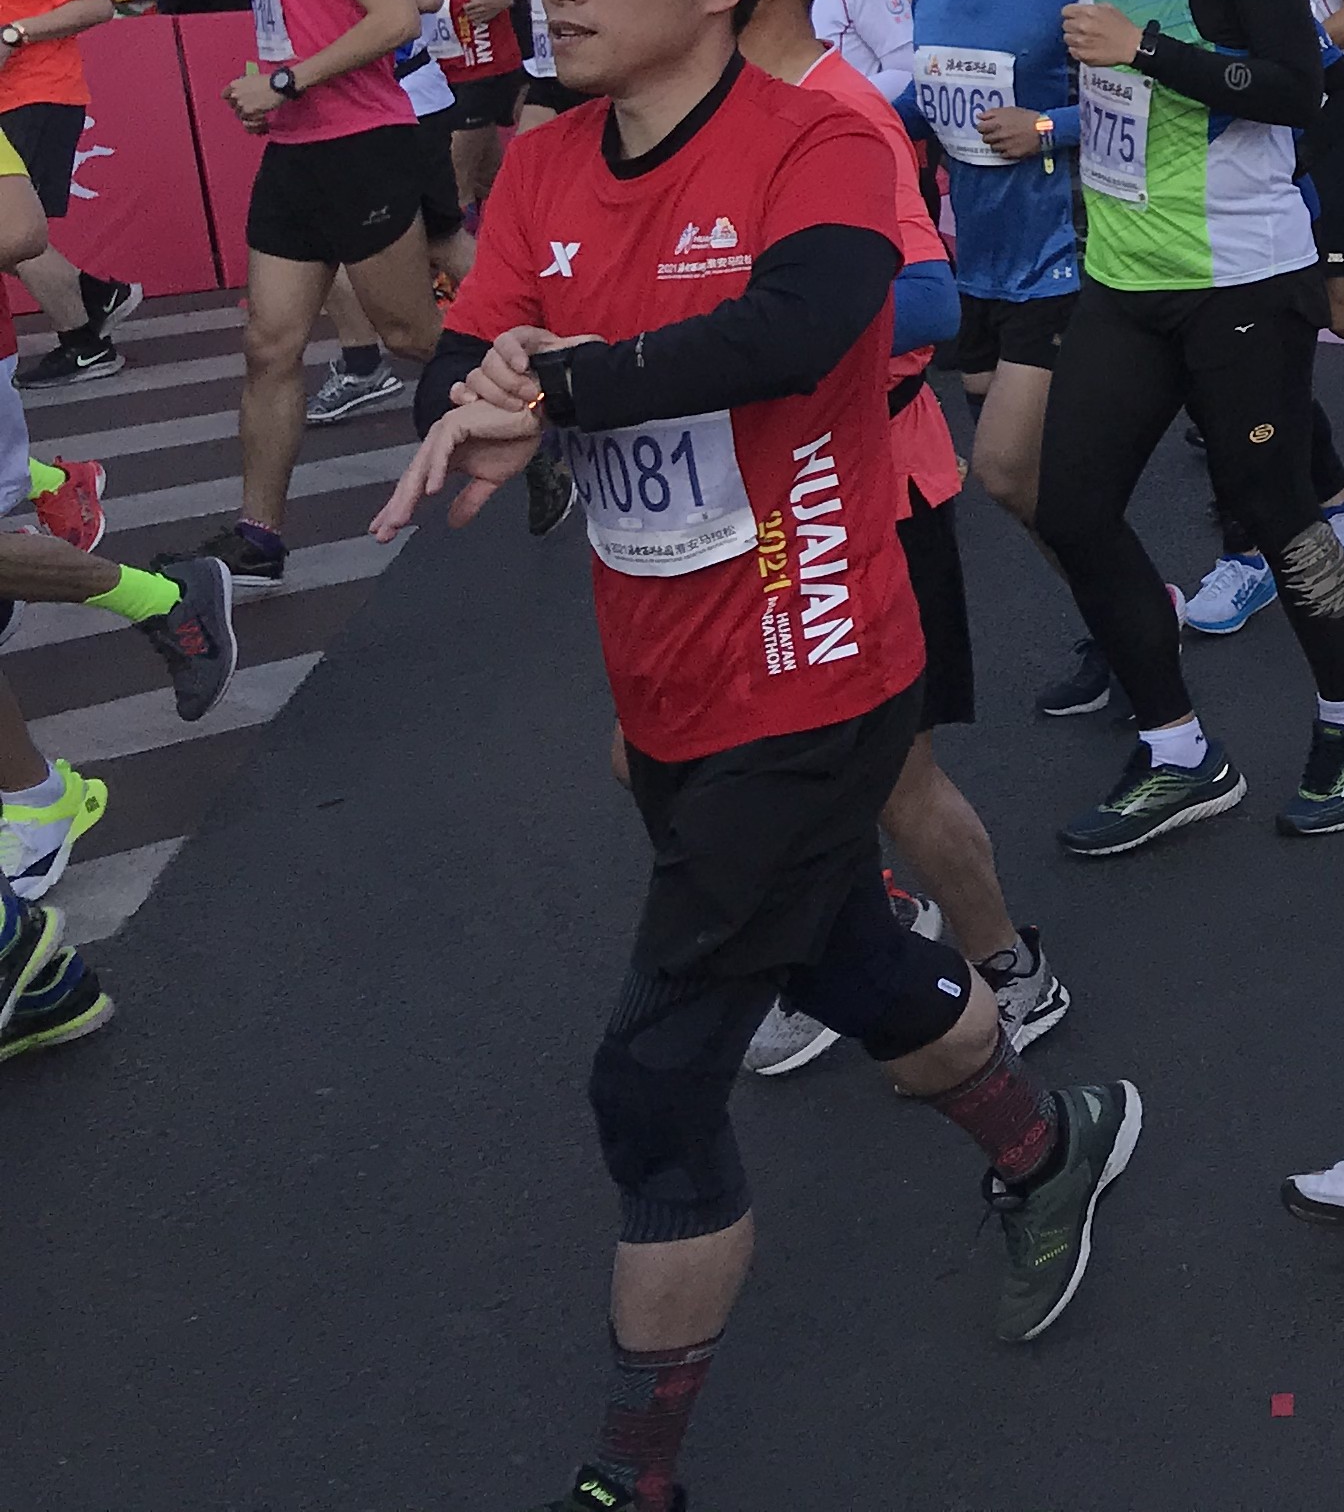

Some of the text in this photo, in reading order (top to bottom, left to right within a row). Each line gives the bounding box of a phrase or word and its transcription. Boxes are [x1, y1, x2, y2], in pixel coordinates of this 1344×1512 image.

[789, 431, 859, 666] HUAIAN
[761, 595, 783, 677] MARATHON
[776, 611, 798, 672] HUAI'AN
